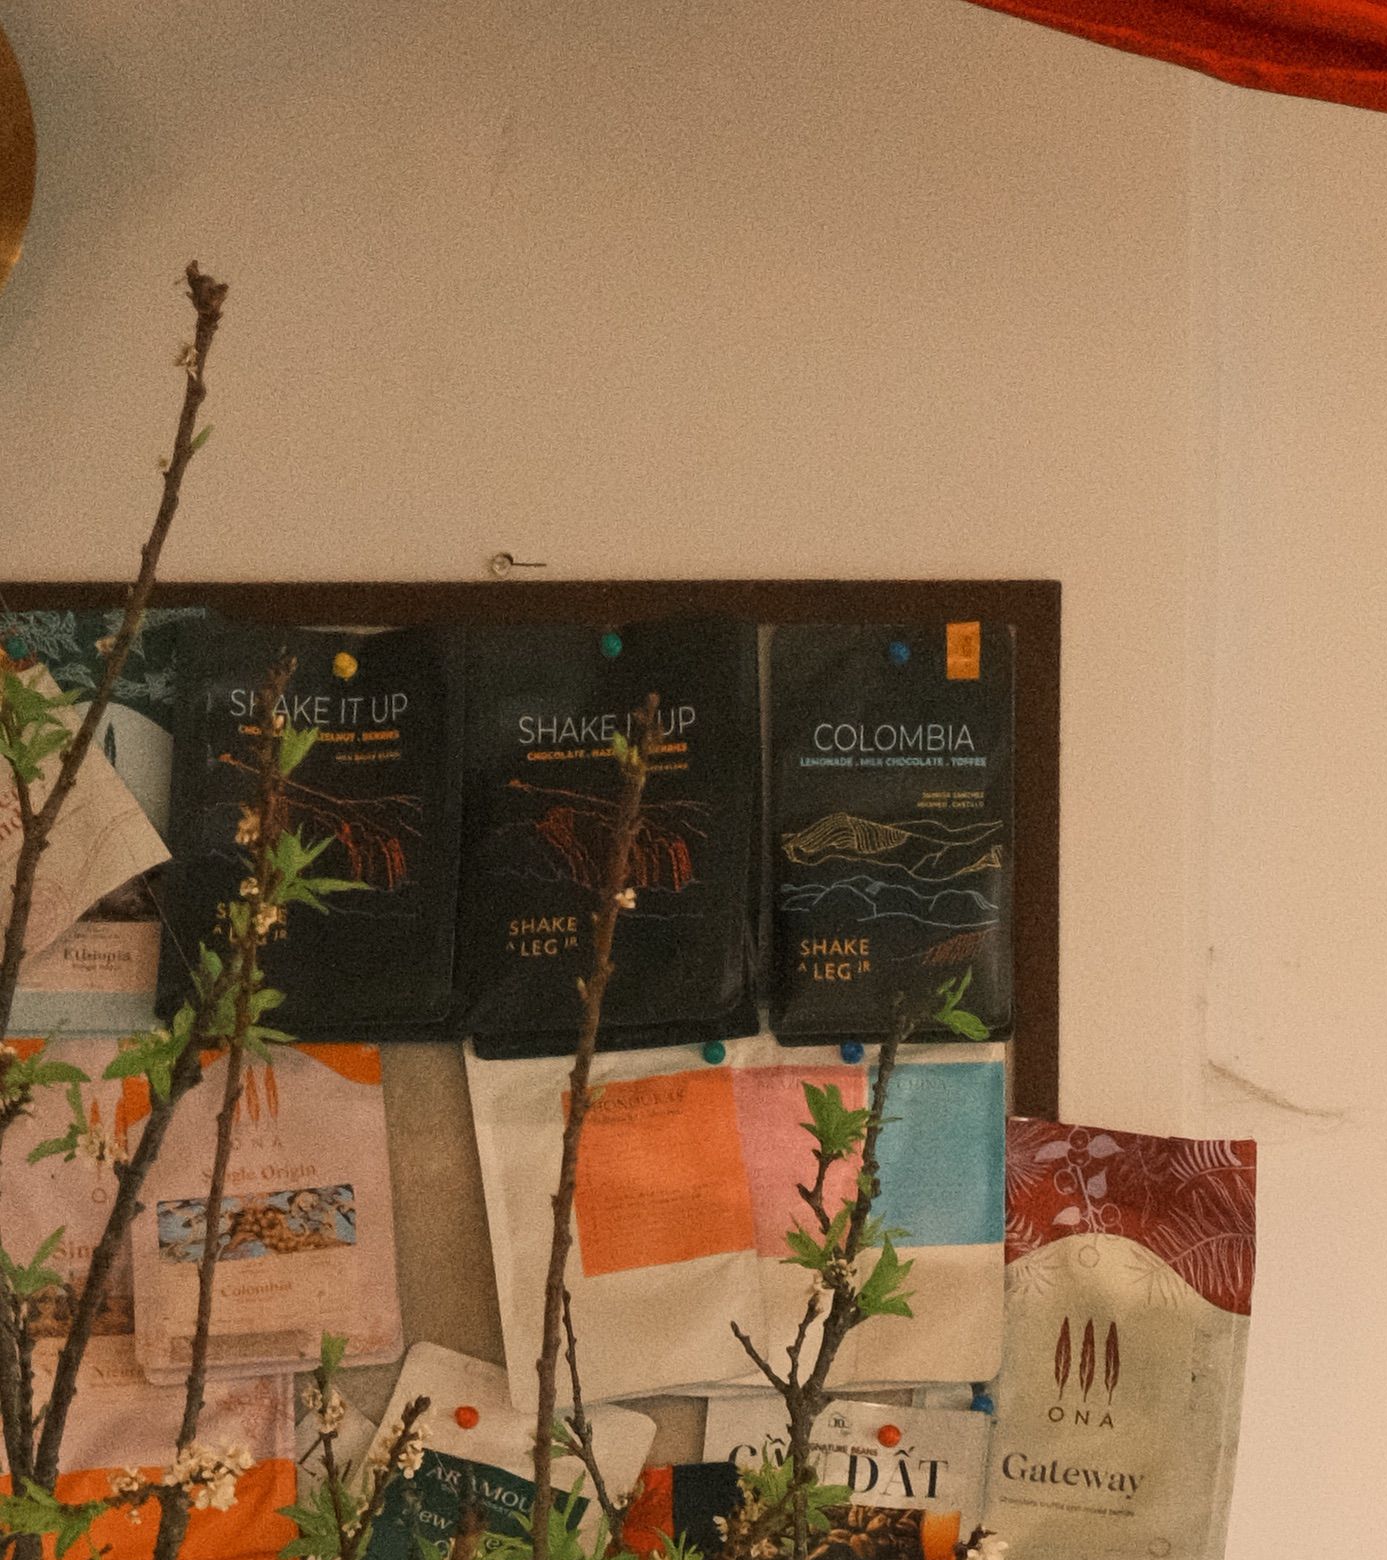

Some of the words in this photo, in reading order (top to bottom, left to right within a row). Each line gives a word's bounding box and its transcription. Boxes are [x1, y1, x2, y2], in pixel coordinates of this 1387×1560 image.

[340, 696, 364, 725] IT
[371, 692, 408, 724] UP
[518, 713, 617, 746] SHAKE
[656, 705, 697, 737] UP
[812, 722, 976, 753] COLOMBIA
[885, 756, 944, 767] CHOCOLATE
[508, 915, 578, 937] SHAKE
[519, 938, 559, 958] LEG
[799, 936, 870, 958] SHAKE
[813, 961, 853, 982] LEG
[1047, 1406, 1114, 1429] ONA
[1002, 1452, 1145, 1500] Gateway
